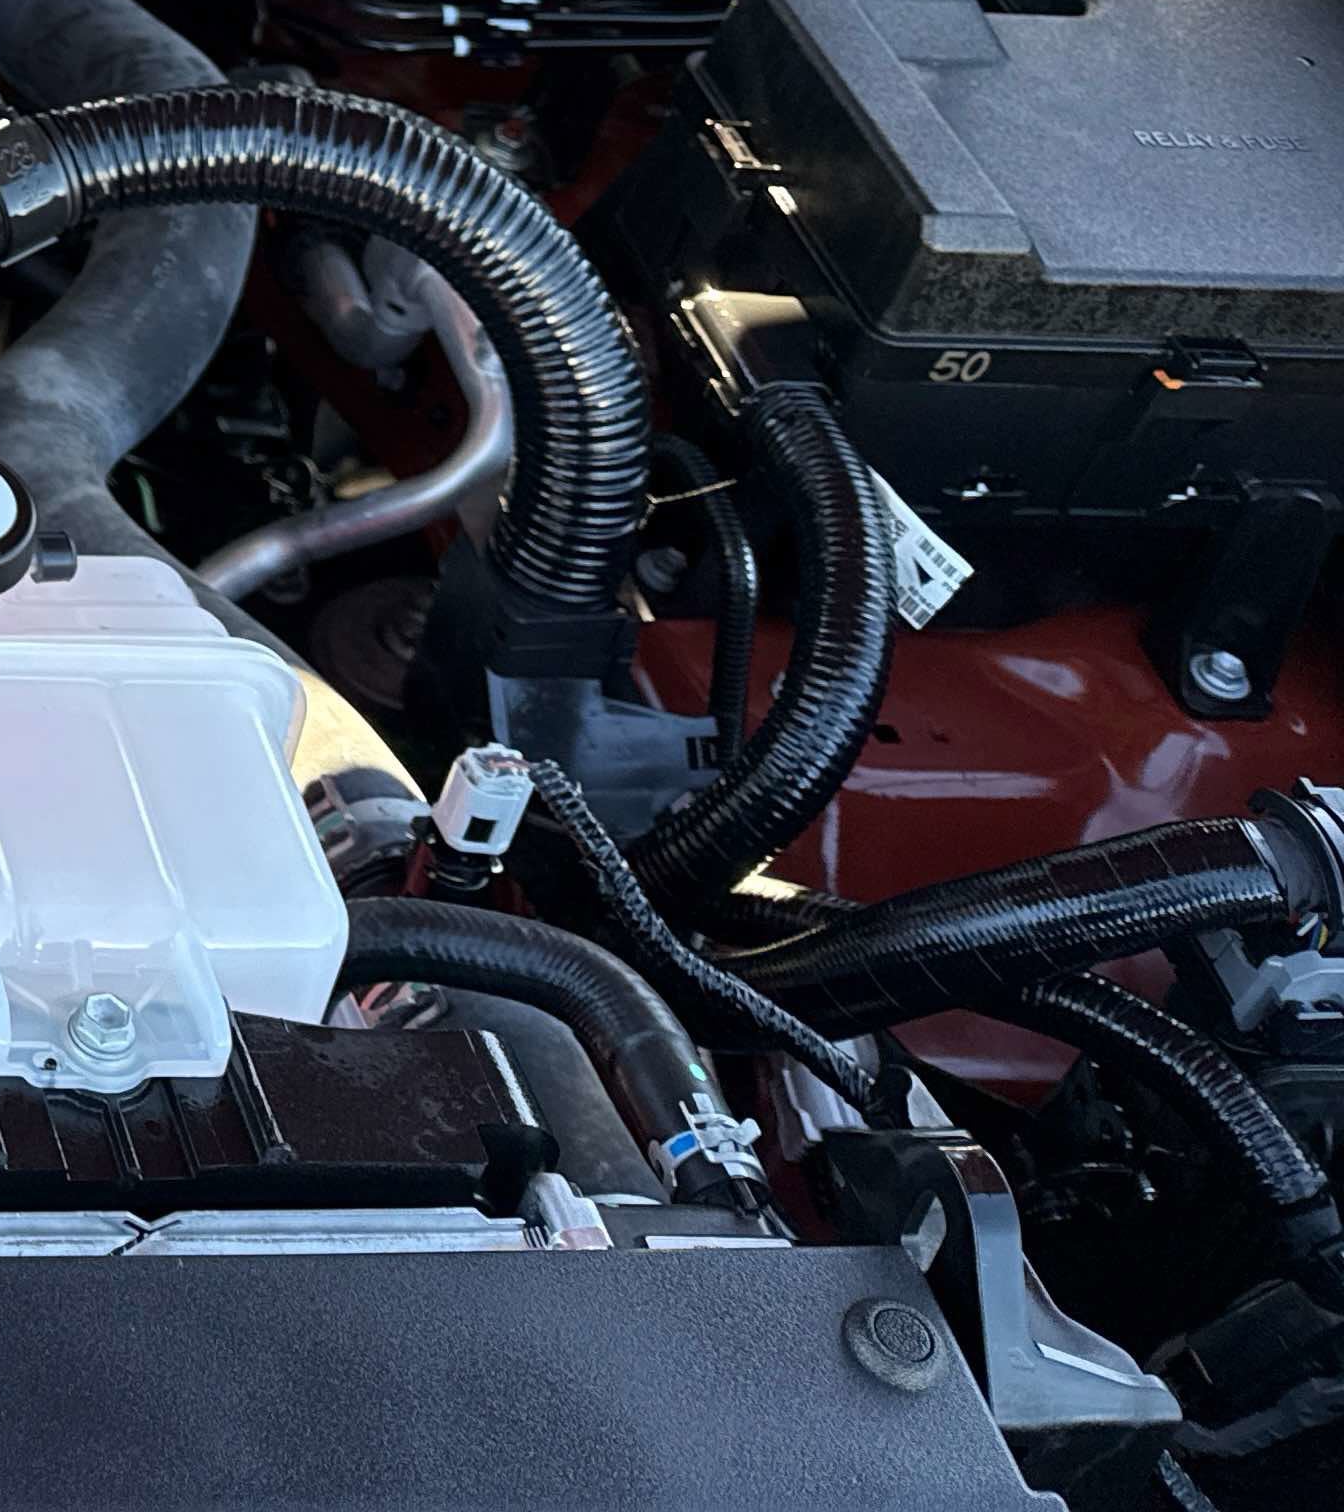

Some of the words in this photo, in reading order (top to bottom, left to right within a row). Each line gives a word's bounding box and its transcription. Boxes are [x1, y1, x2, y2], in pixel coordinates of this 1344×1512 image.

[1133, 129, 1214, 149] RELAY
[1241, 136, 1312, 153] FUSE
[928, 350, 992, 382] 50
